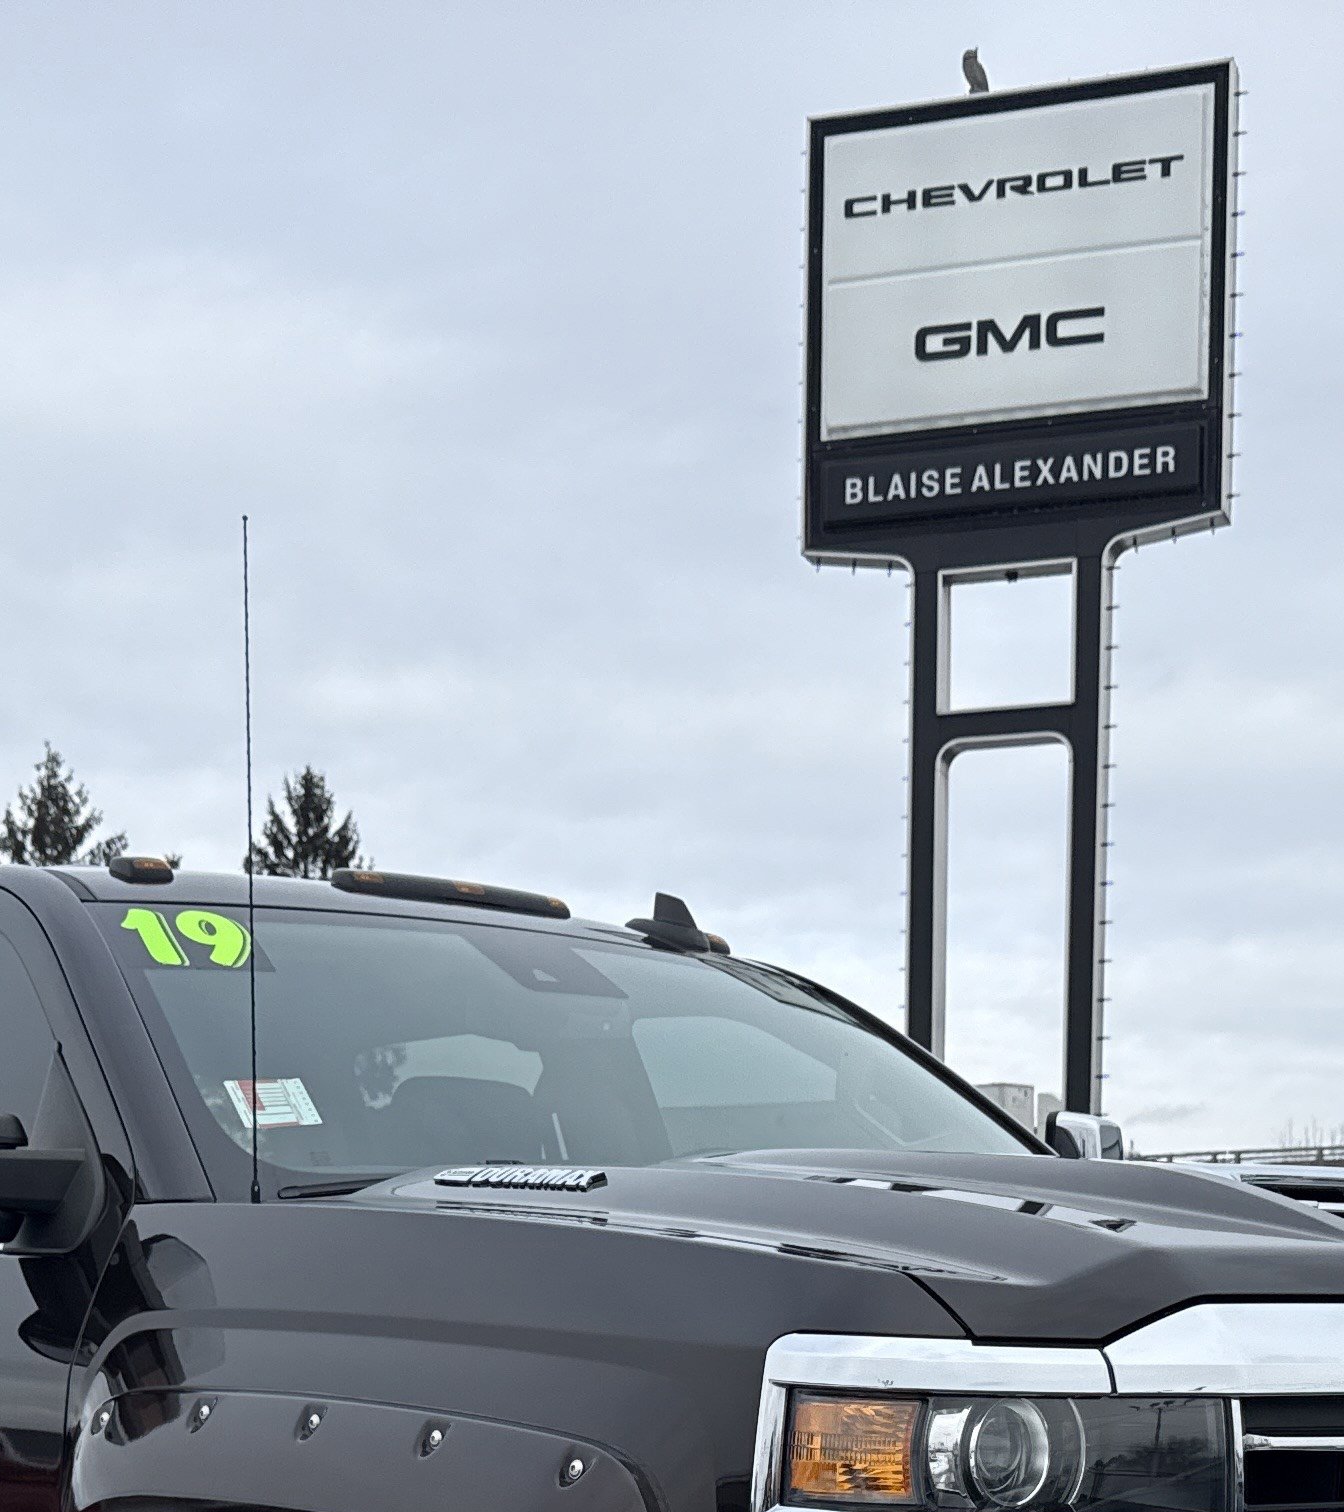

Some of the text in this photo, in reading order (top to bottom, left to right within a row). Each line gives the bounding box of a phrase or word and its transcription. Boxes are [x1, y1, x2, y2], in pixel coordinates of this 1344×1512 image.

[844, 154, 1185, 219] CHEVROLET
[914, 306, 1106, 363] GMC
[844, 446, 1176, 505] BLAISE ALEXANDER
[120, 908, 252, 968] 19
